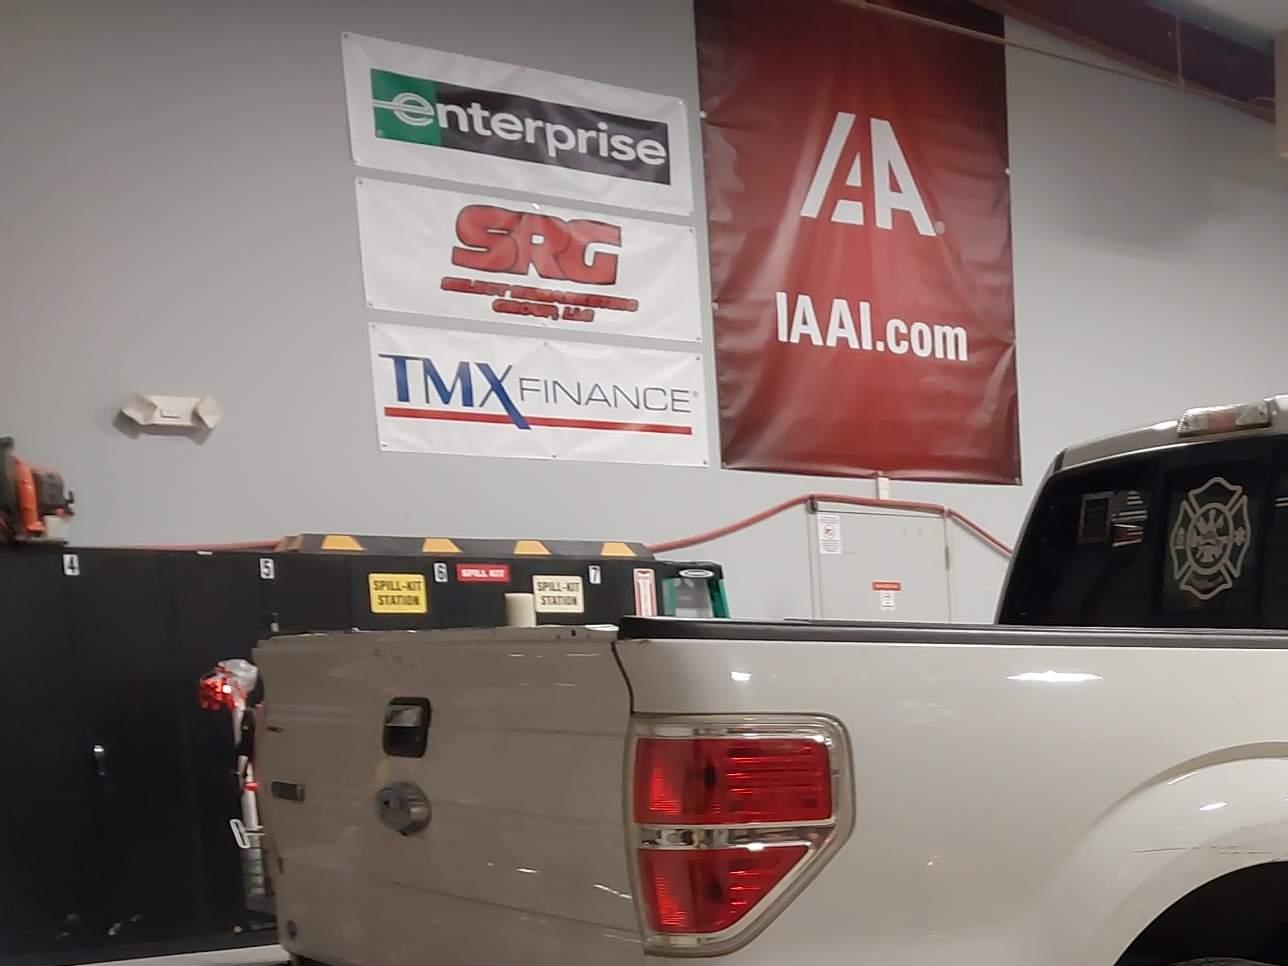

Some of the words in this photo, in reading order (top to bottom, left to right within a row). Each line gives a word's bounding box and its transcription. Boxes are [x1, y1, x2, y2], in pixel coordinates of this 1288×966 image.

[388, 92, 667, 166] enterprise
[451, 204, 622, 286] SRG
[776, 291, 968, 361] IAAI.com
[378, 353, 532, 430] TMX
[518, 377, 692, 413] FINANCE
[66, 556, 77, 573] 4
[262, 560, 272, 577] 5
[437, 565, 445, 581] 6
[591, 567, 600, 583] 7
[373, 580, 422, 592] SPILL-KIT
[537, 581, 580, 592] SPILL-KIT
[377, 595, 420, 606] STATION
[541, 595, 577, 606] STATION
